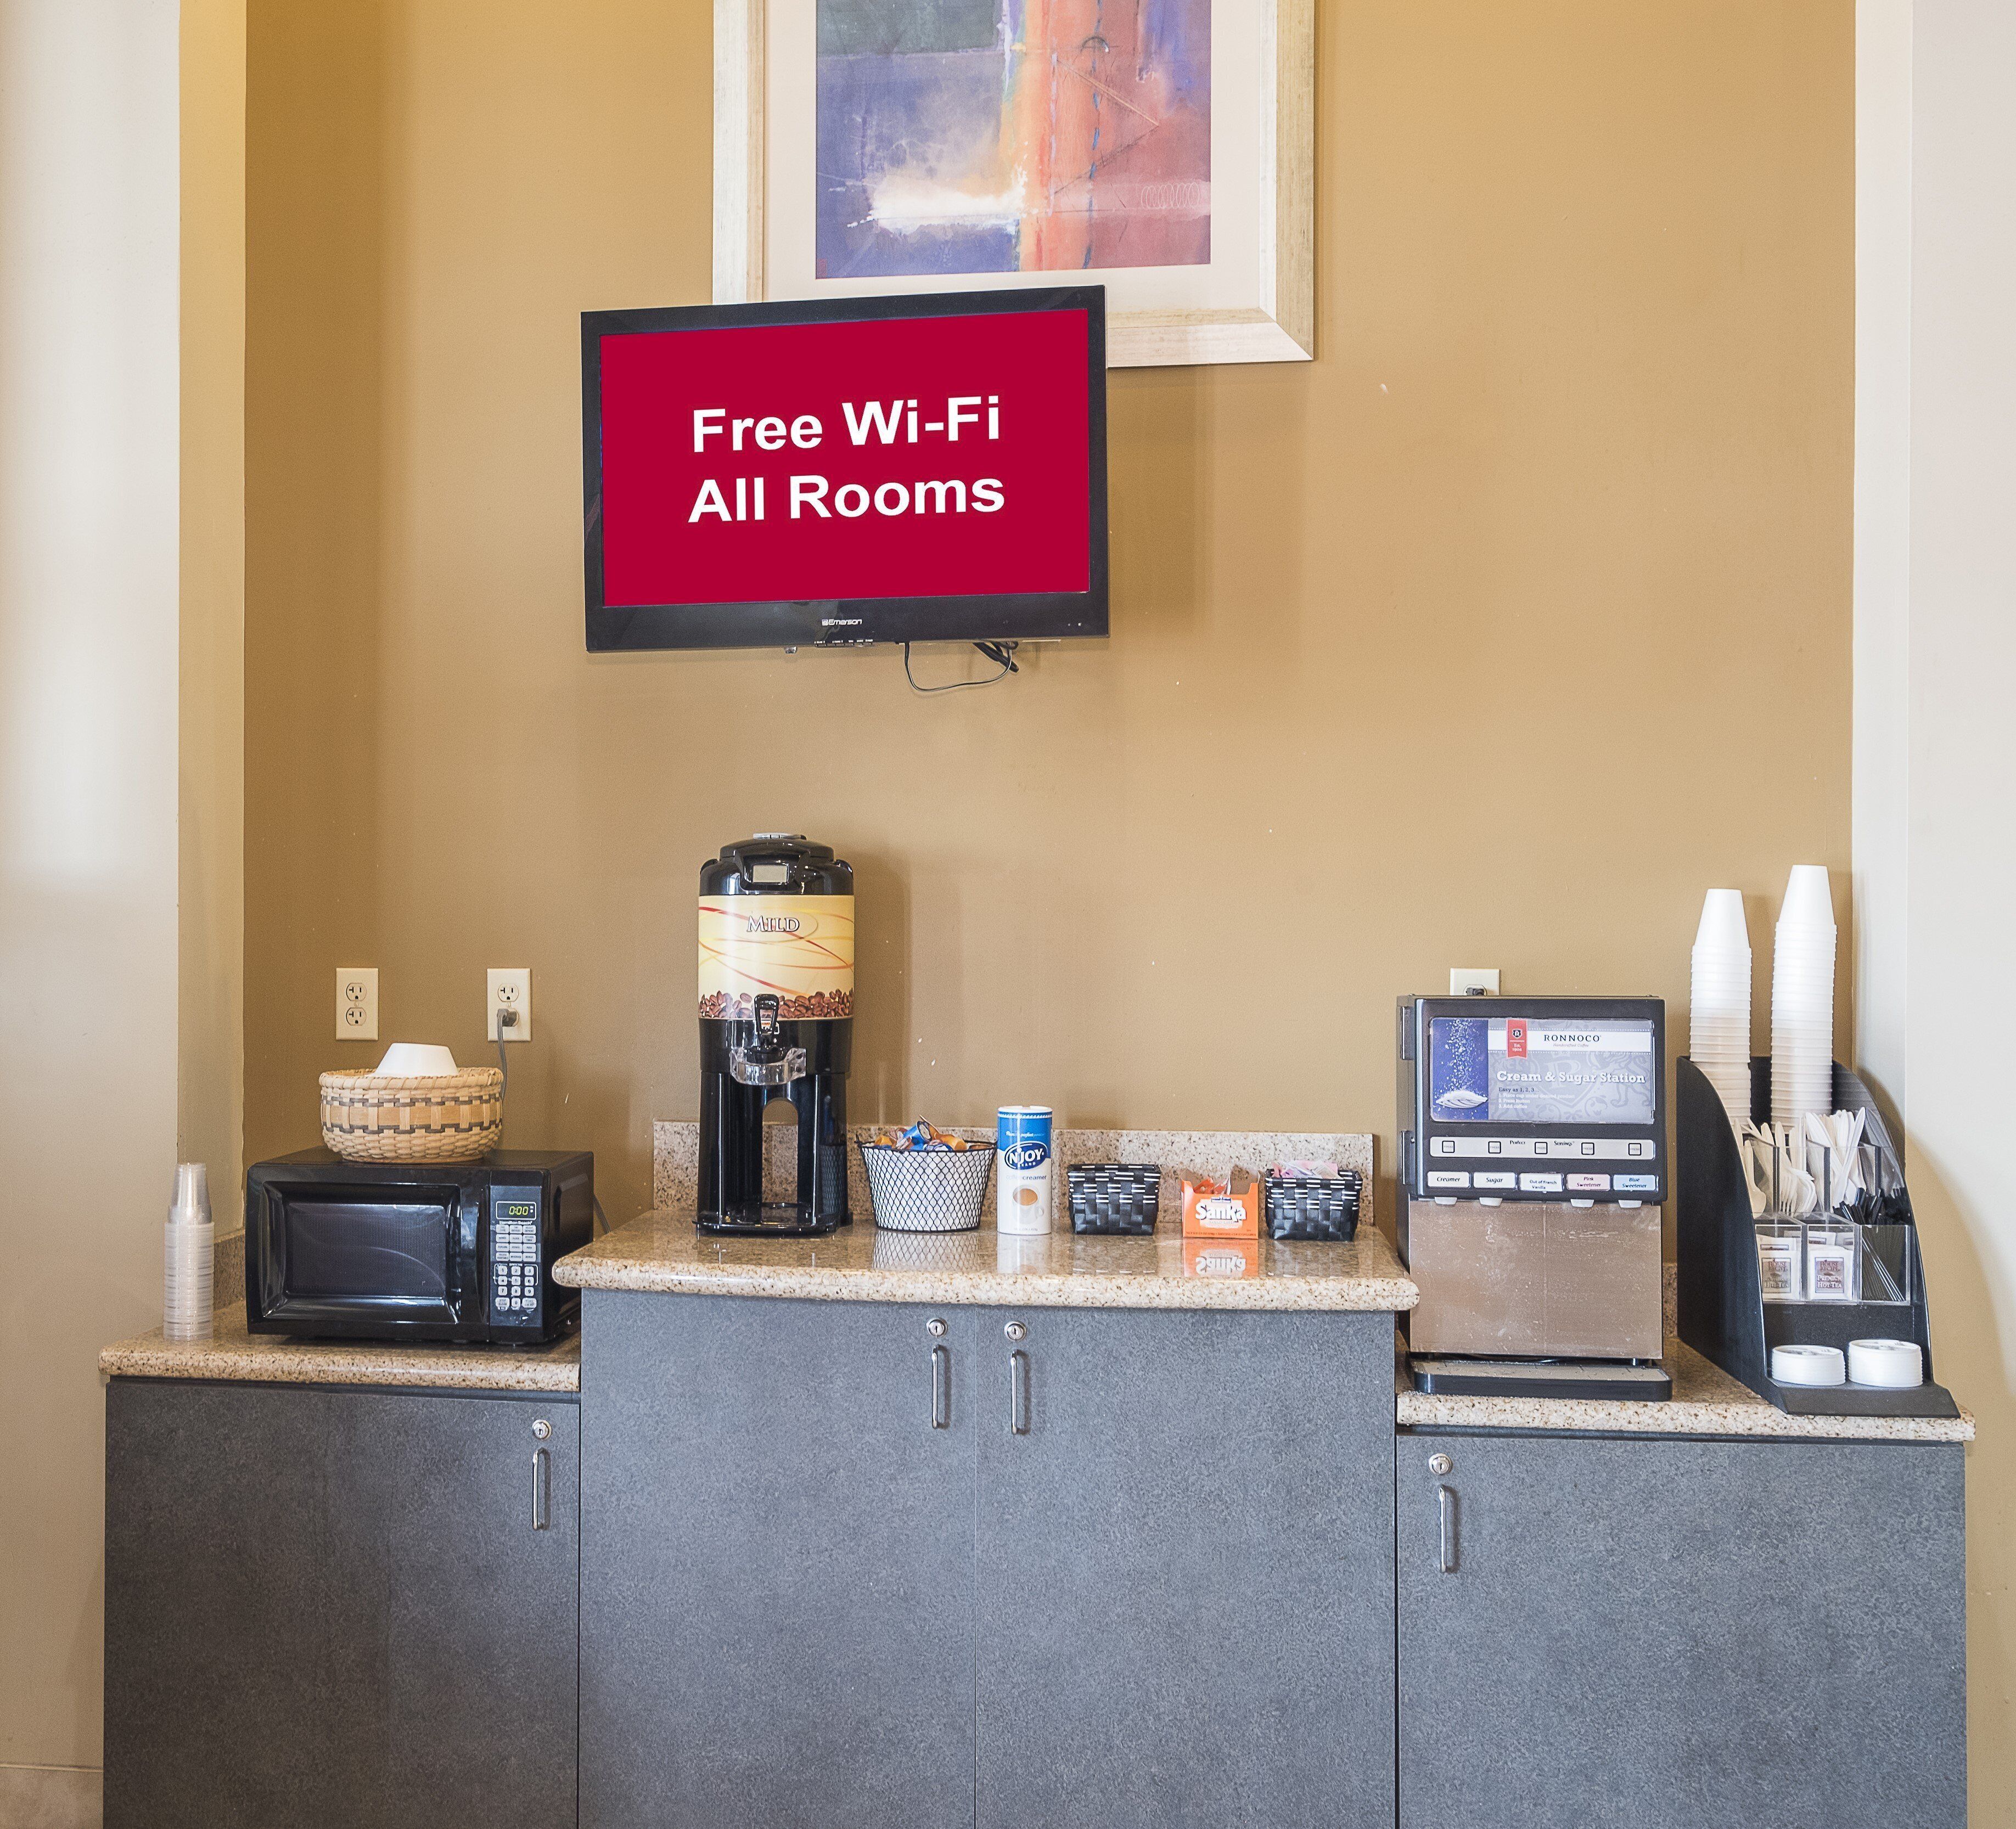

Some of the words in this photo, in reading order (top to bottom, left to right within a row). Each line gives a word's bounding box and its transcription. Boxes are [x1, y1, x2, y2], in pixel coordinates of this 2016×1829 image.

[694, 409, 822, 452] Free
[842, 396, 998, 445] Wi-Fi
[688, 477, 764, 522] All
[790, 475, 1004, 519] Rooms
[746, 915, 800, 932] MILD
[1496, 1071, 1542, 1082] Cream
[1545, 1071, 1555, 1082] &
[1559, 1072, 1597, 1085] Sugar
[1600, 1072, 1646, 1084] Station
[509, 1206, 529, 1215] 0:00
[1195, 1203, 1246, 1222] Sanka
